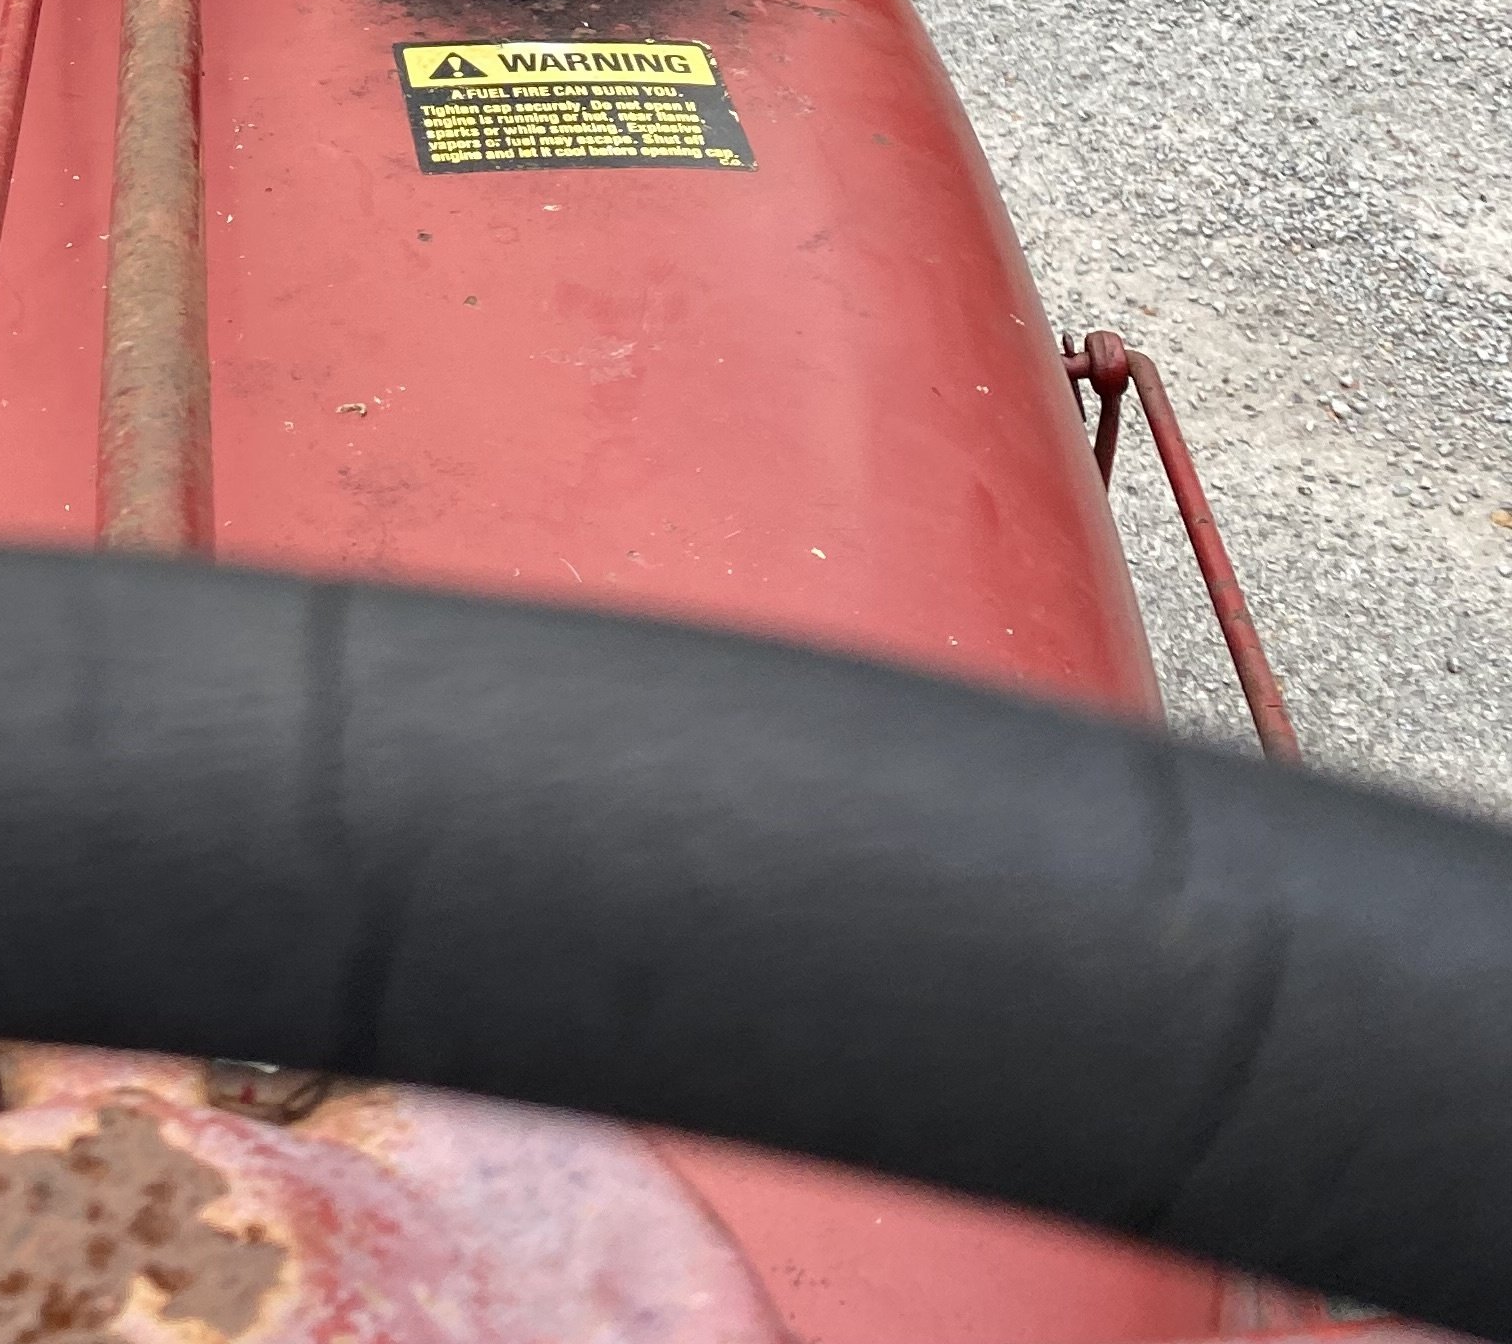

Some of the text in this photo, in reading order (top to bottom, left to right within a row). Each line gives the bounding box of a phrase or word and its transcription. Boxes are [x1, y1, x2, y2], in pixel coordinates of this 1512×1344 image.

[497, 52, 692, 74] WARNING
[451, 85, 684, 100] A FUEL FIRE CAN BURN YOU.
[420, 100, 696, 117] Tighten cap securely. Do not open if
[423, 115, 477, 128] engine
[478, 114, 494, 124] is
[497, 113, 559, 124] running
[562, 113, 579, 123] or
[617, 112, 653, 122] near
[426, 122, 702, 140] sparks or while smoking. Explosive
[428, 133, 705, 151] vapors or fuel may escape. Shut off
[431, 145, 739, 163] engine and let it cool before opening cap.
